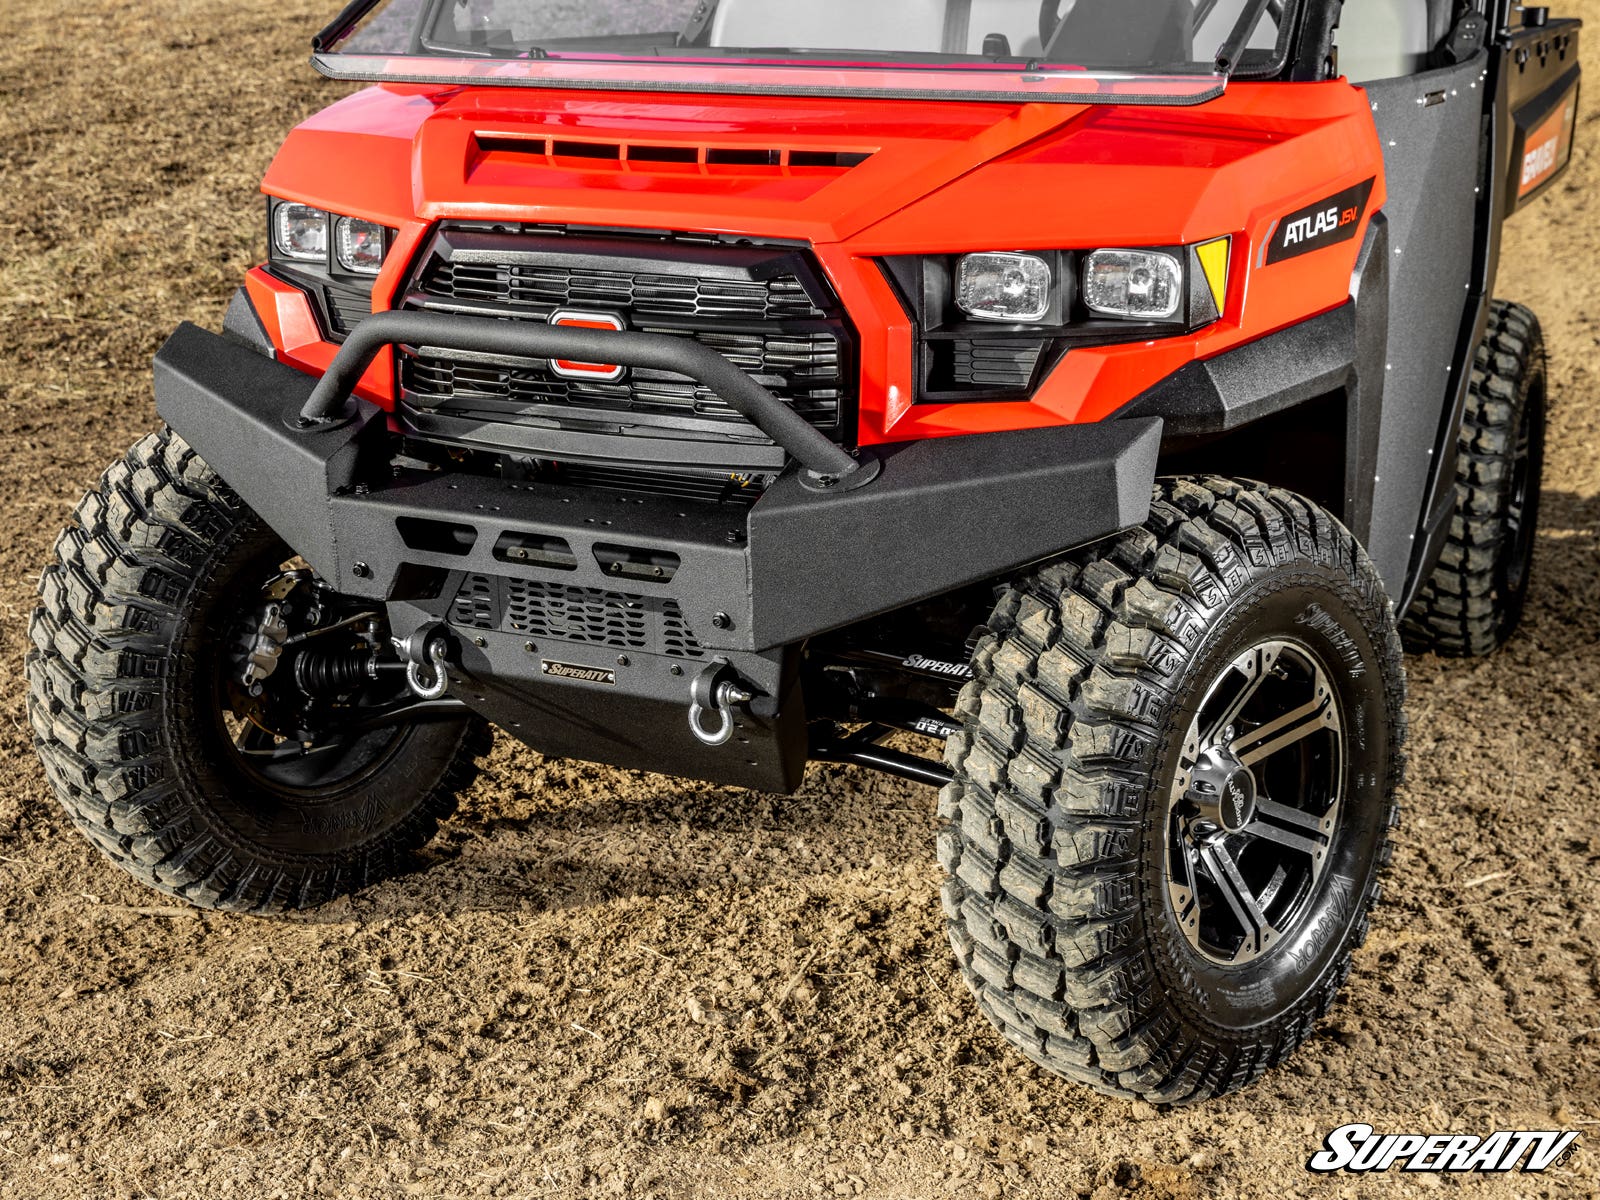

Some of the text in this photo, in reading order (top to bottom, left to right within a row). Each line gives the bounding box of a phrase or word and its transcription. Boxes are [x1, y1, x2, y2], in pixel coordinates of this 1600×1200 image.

[1283, 206, 1358, 248] ATLAS JSV
[548, 663, 608, 682] SUPERATV
[1285, 872, 1355, 974] WARRIOR
